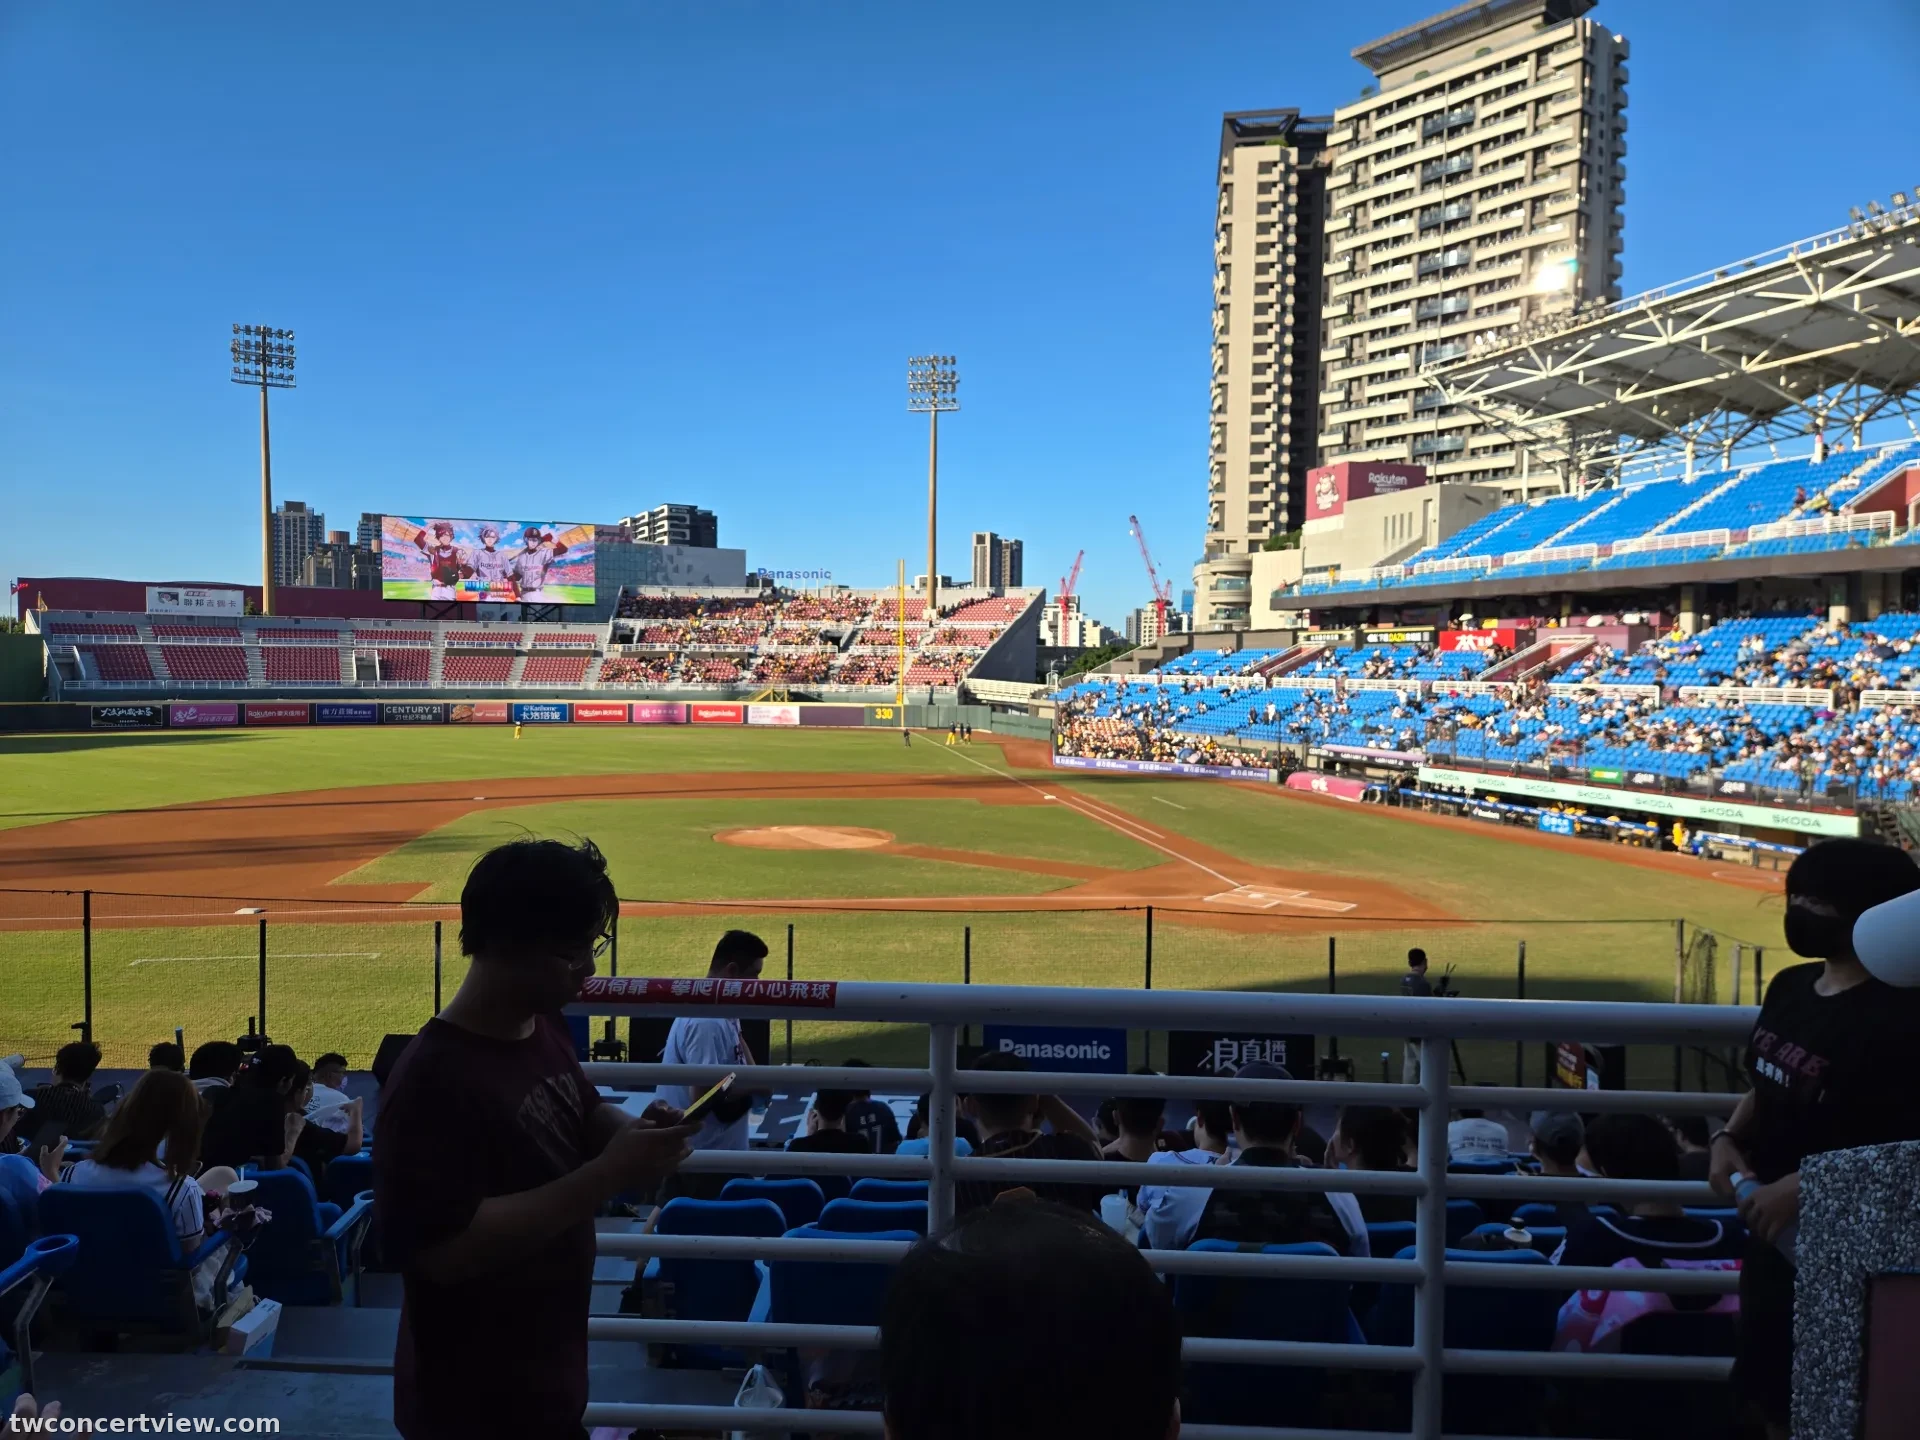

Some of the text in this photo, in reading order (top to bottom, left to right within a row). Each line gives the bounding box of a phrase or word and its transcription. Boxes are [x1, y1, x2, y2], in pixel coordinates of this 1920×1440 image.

[1368, 472, 1407, 486] Rakuten
[757, 567, 831, 579] Panasonic
[248, 710, 277, 718] Rakuten
[875, 708, 893, 719] 330
[1700, 805, 1744, 818] SKODA
[1772, 814, 1822, 828] SKODA
[585, 978, 831, 999] 勿倚靠、攀爬 請小心飛球
[999, 1038, 1111, 1060] Panasonic
